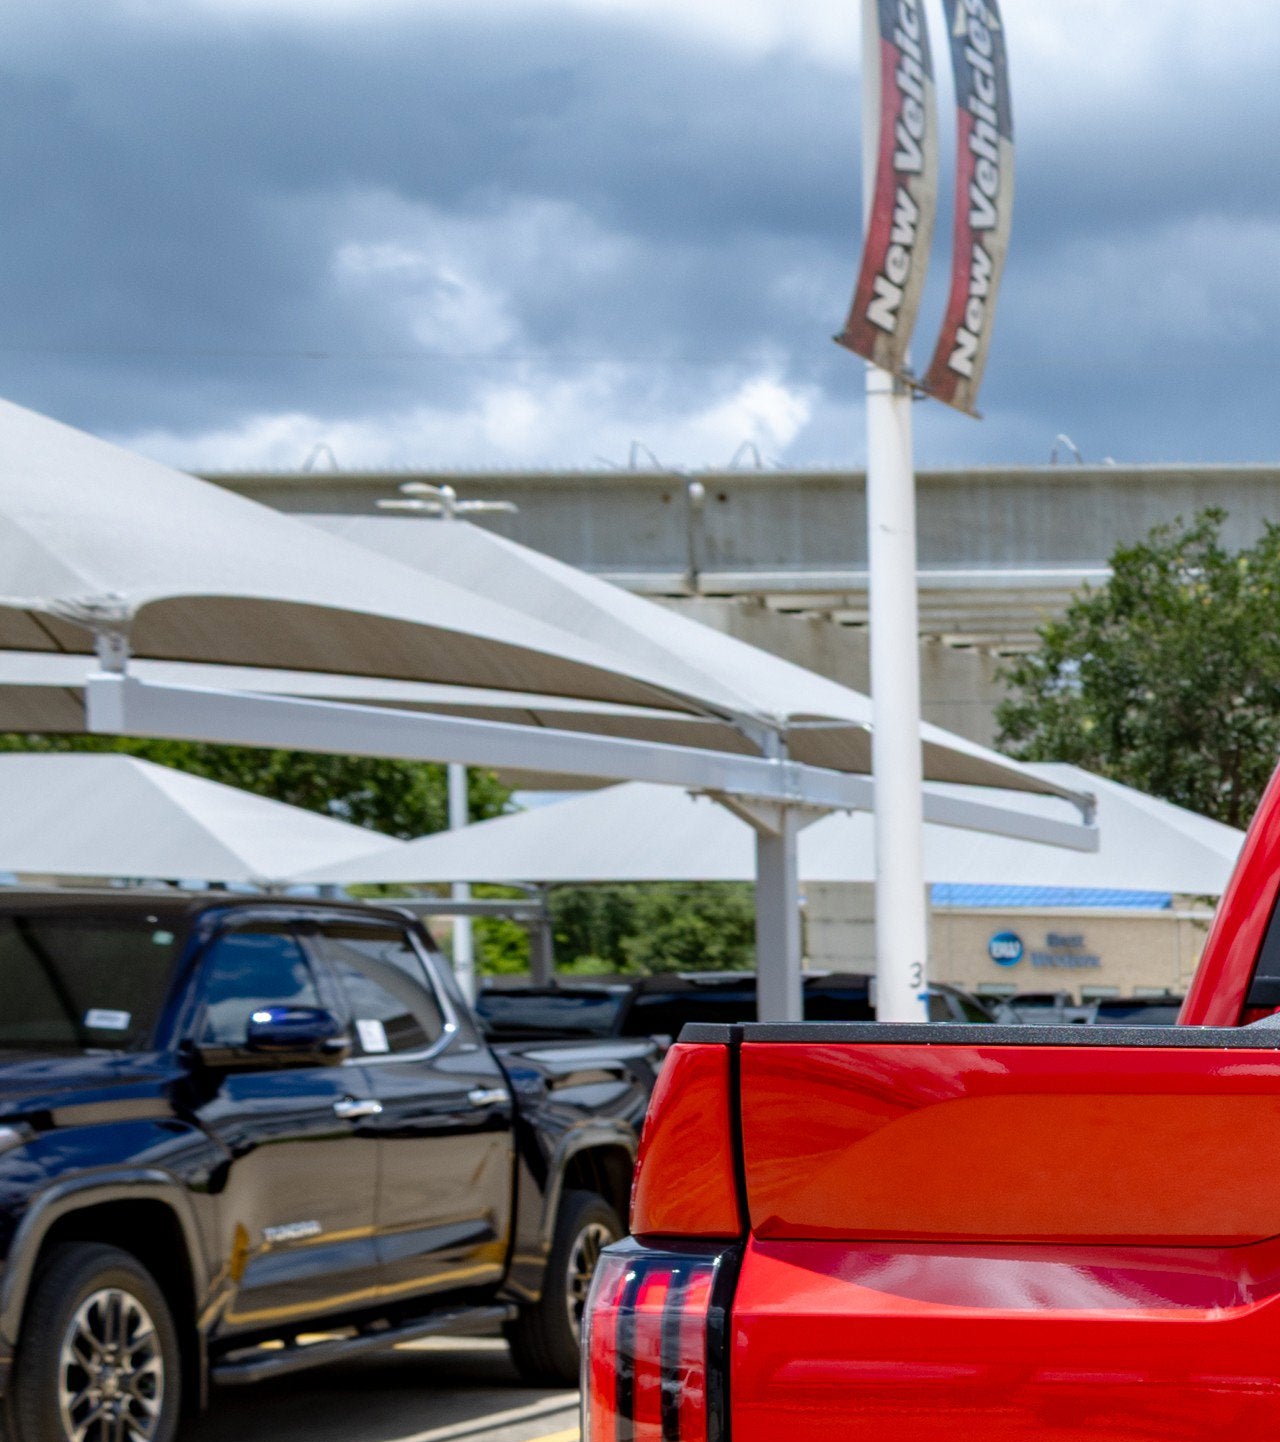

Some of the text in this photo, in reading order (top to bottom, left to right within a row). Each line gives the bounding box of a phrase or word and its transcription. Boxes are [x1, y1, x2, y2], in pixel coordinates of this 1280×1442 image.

[866, 0, 924, 334] New Vehic
[948, 246, 994, 379] New
